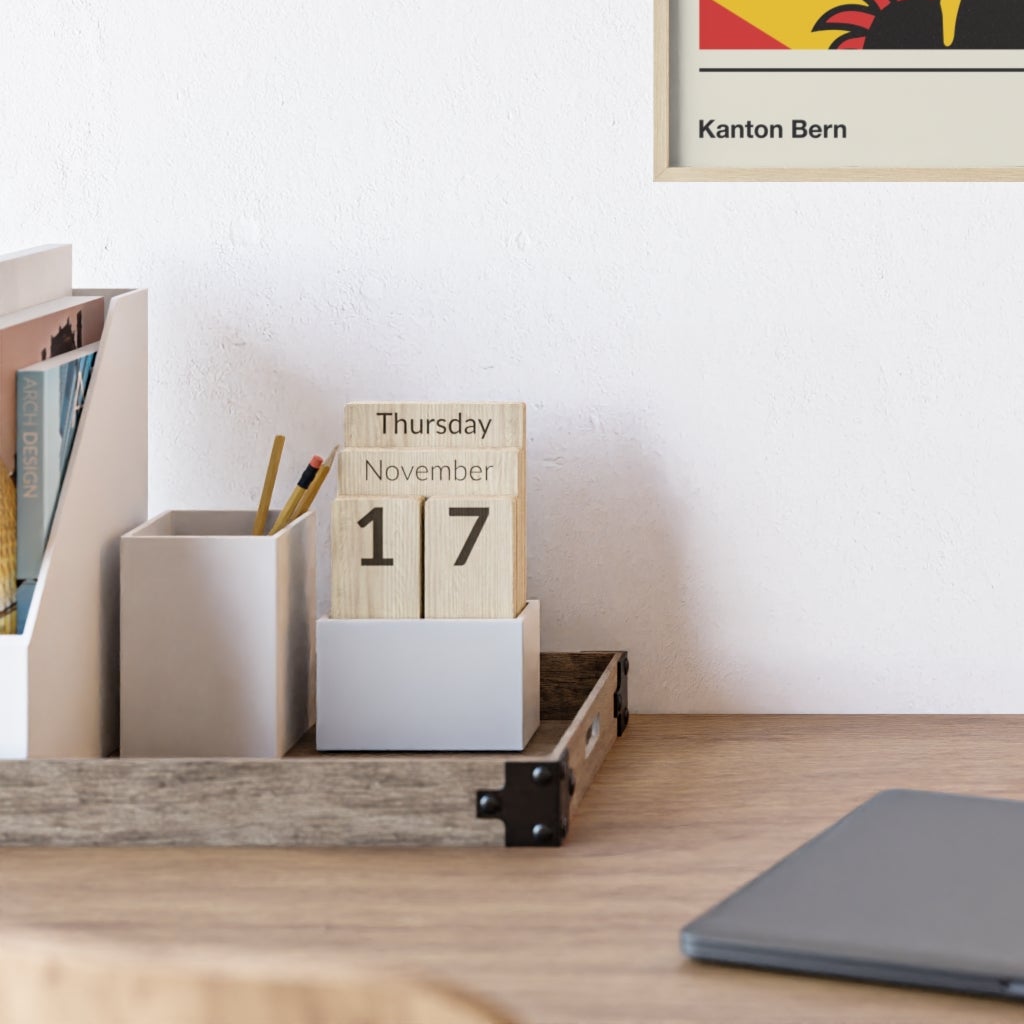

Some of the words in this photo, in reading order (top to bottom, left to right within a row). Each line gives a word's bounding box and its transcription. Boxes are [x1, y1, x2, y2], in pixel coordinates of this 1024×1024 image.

[698, 119, 783, 139] Kanton
[791, 119, 847, 139] Bern
[23, 376, 38, 427] ARCH
[376, 412, 492, 439] Thursday
[22, 431, 38, 498] DESIGN
[364, 459, 494, 482] November
